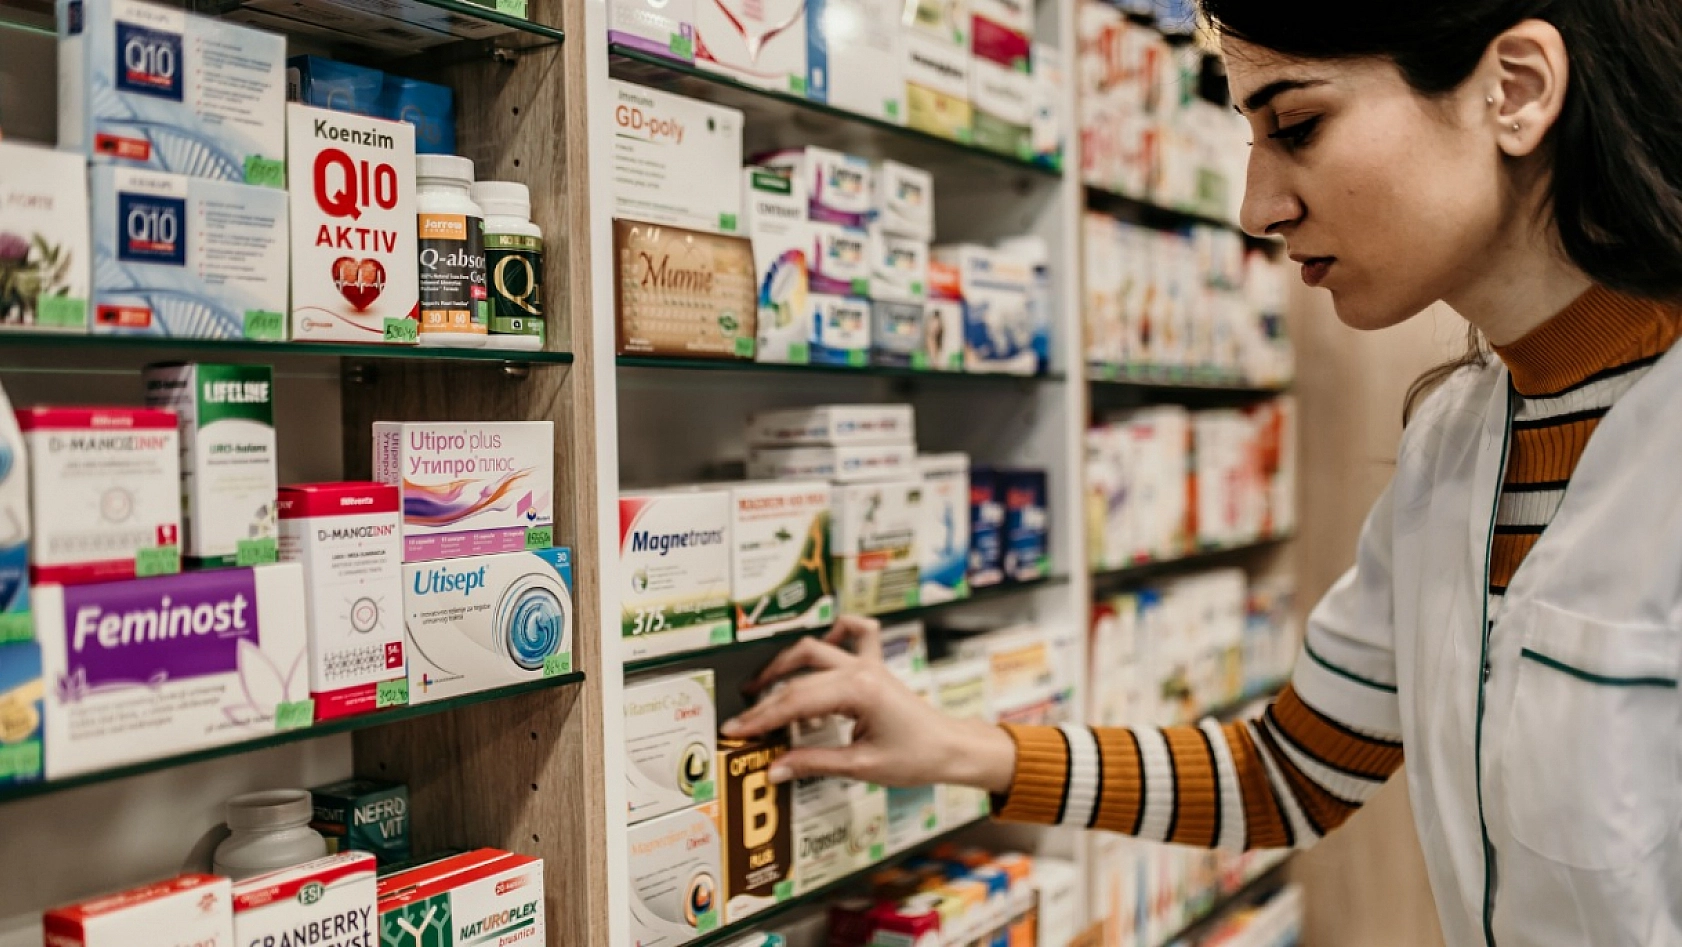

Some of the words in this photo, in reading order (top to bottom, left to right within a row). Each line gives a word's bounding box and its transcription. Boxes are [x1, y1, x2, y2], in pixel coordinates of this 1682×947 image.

[125, 39, 175, 77] Q10
[314, 119, 394, 150] Koenzim
[615, 105, 685, 145] GD-poly
[313, 148, 398, 221] Q10
[127, 210, 177, 244] Q10
[315, 224, 398, 254] AKTIV
[203, 380, 269, 404] LIFELINE
[411, 431, 465, 454] Utipro
[469, 429, 503, 453] plus
[409, 456, 476, 478] Утипро
[479, 456, 515, 473] плюс
[317, 525, 393, 541] D-MANOZINN
[632, 528, 723, 556] Magnetrans
[413, 565, 486, 596] Utisept
[73, 593, 248, 652] Feminost
[632, 608, 665, 636] 375
[354, 797, 406, 827] NEFRO
[742, 770, 778, 849] B
[379, 815, 405, 839] VIT
[301, 884, 321, 905] ESI
[460, 900, 539, 941] NATUROPLEX
